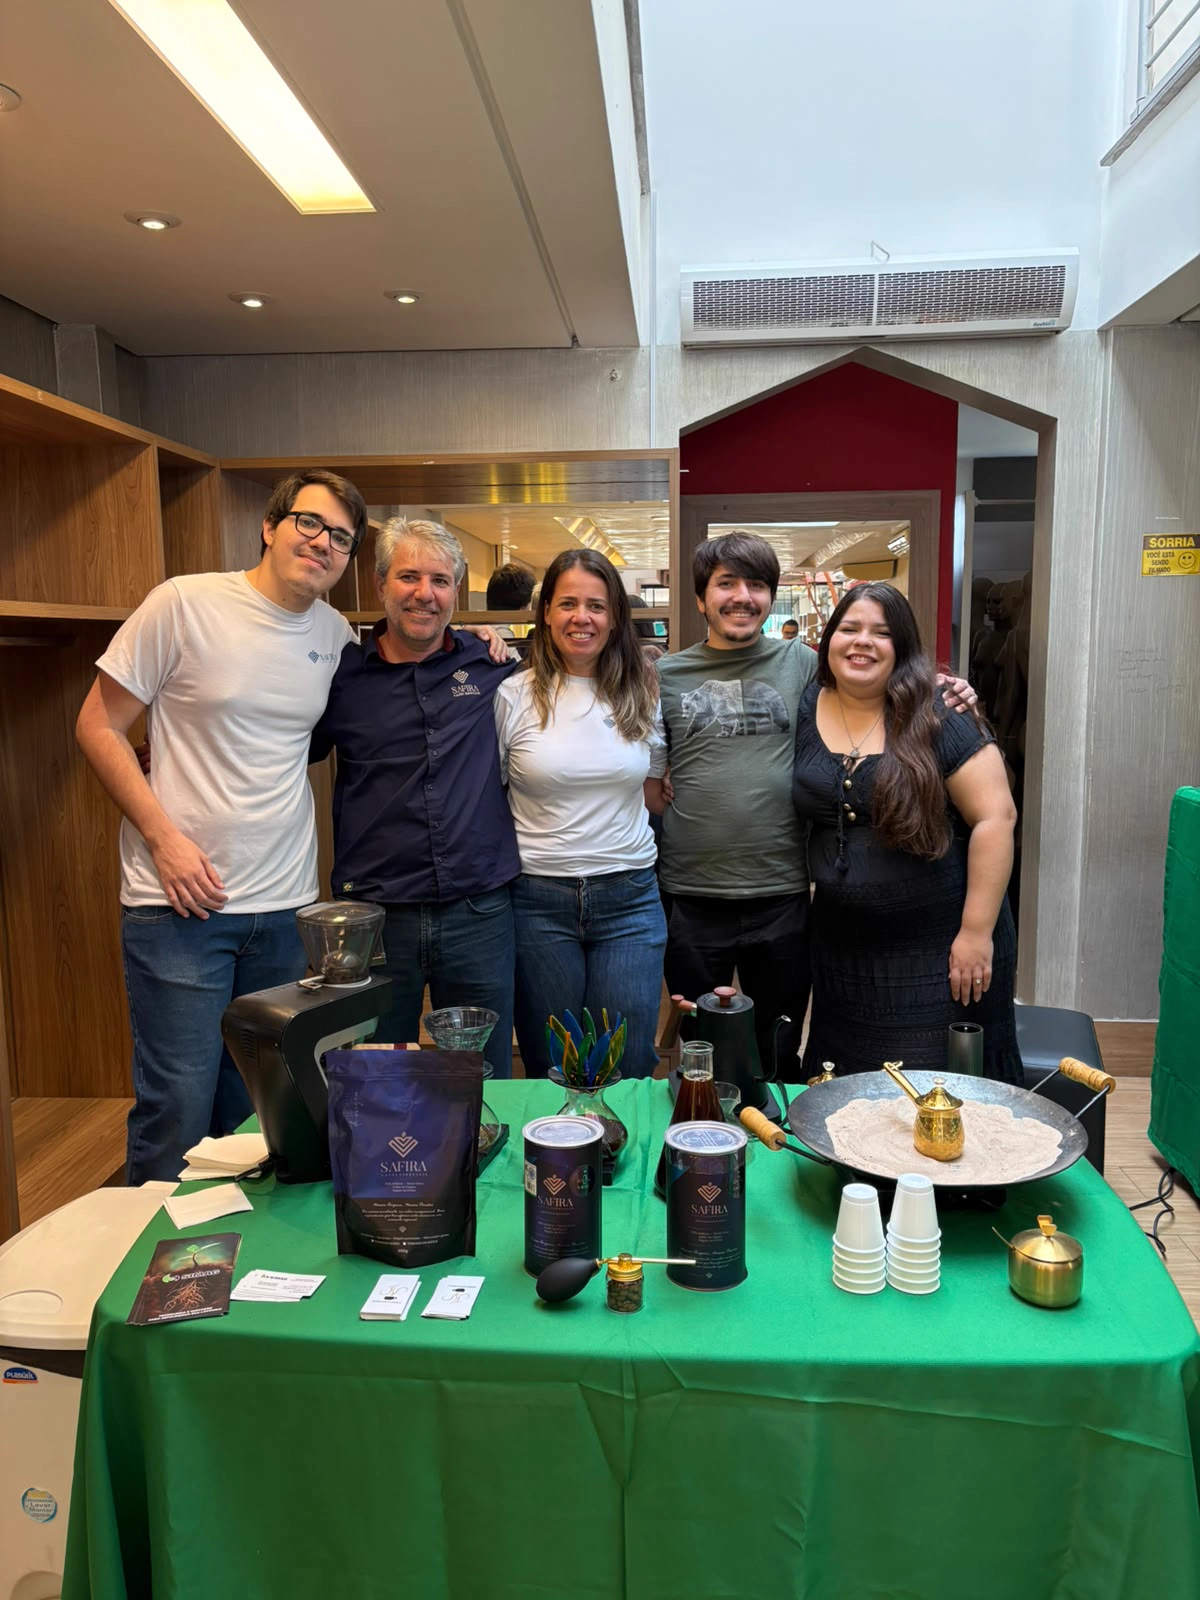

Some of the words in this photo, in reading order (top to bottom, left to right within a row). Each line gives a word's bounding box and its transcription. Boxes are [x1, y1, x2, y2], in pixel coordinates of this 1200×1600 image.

[1149, 537, 1195, 548] SORRIA
[451, 684, 480, 694] SAFIRA
[380, 1161, 427, 1172] SAFIRA
[537, 1195, 573, 1207] SAFIRA
[691, 1203, 728, 1215] SAFIRA
